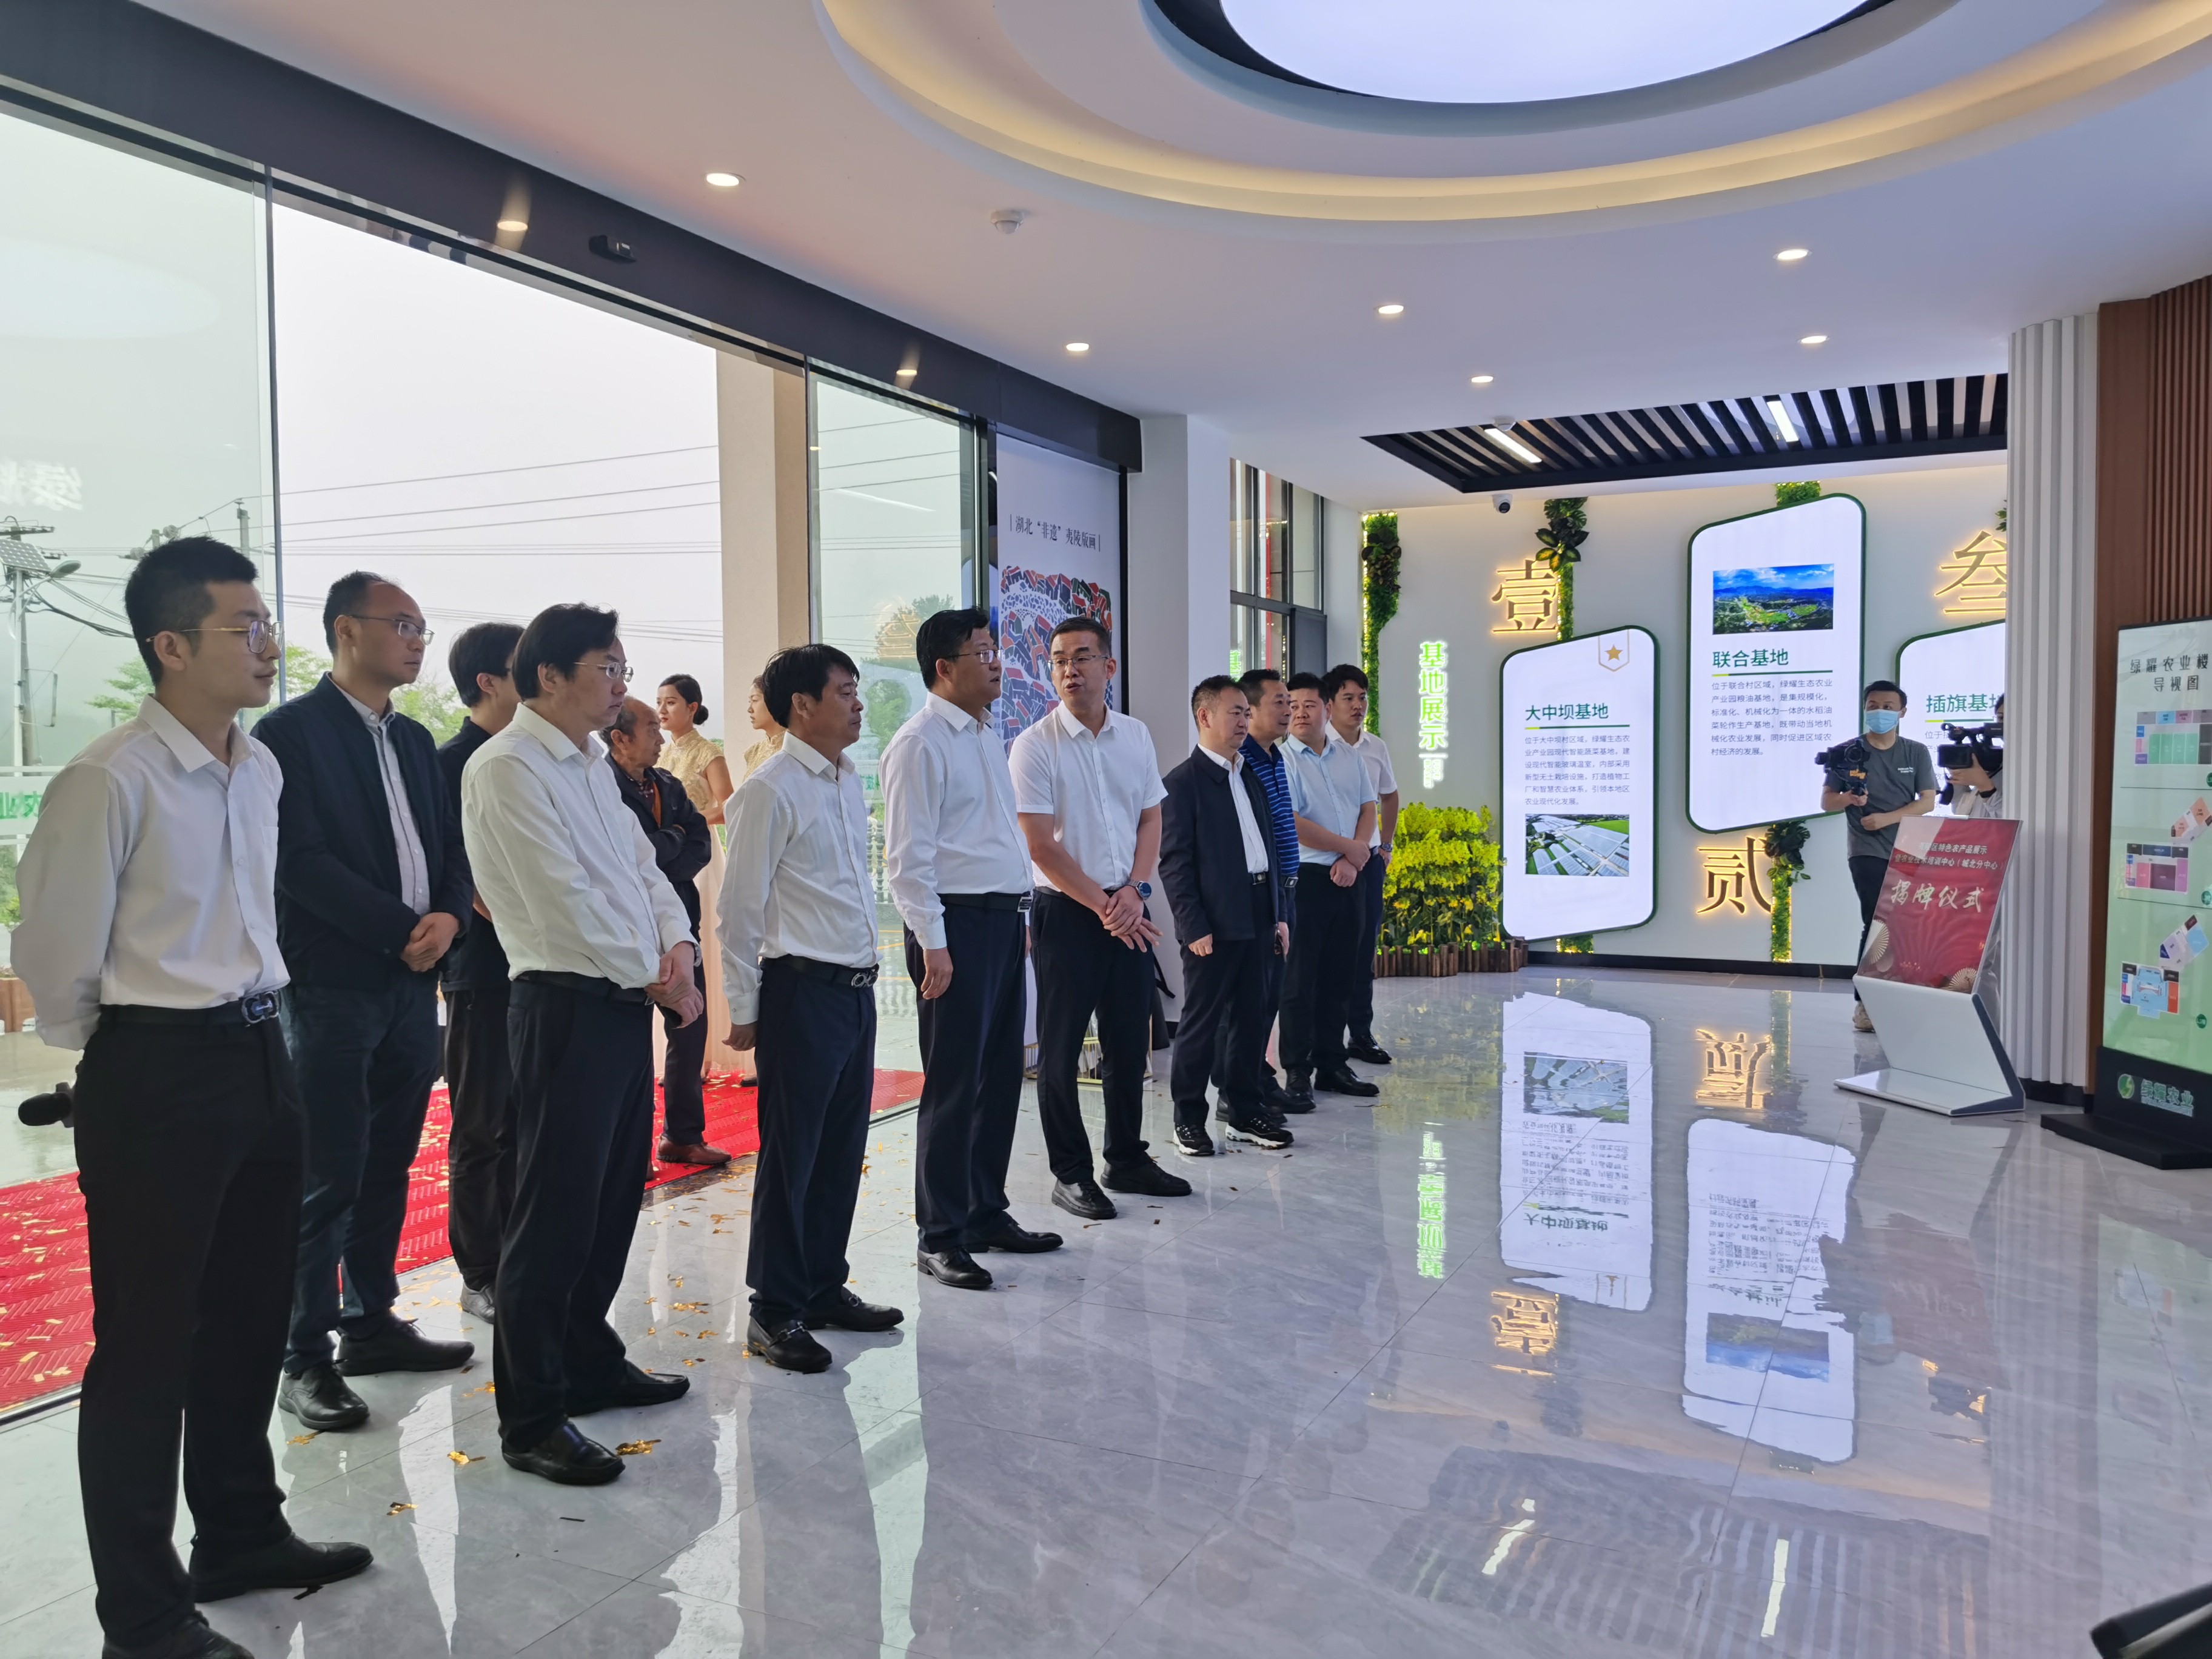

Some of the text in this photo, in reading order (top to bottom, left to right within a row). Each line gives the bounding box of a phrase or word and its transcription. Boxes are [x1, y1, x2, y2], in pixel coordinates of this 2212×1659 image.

[1491, 559, 1560, 634] 壹
[1712, 648, 1789, 668] 联合基地
[1419, 642, 1447, 749] 基地展示
[2154, 675, 2199, 692] 导视图
[1525, 703, 1609, 721] 大中坝基地
[1697, 836, 1771, 914] 贰
[1891, 879, 1985, 913] 揭牌仪式
